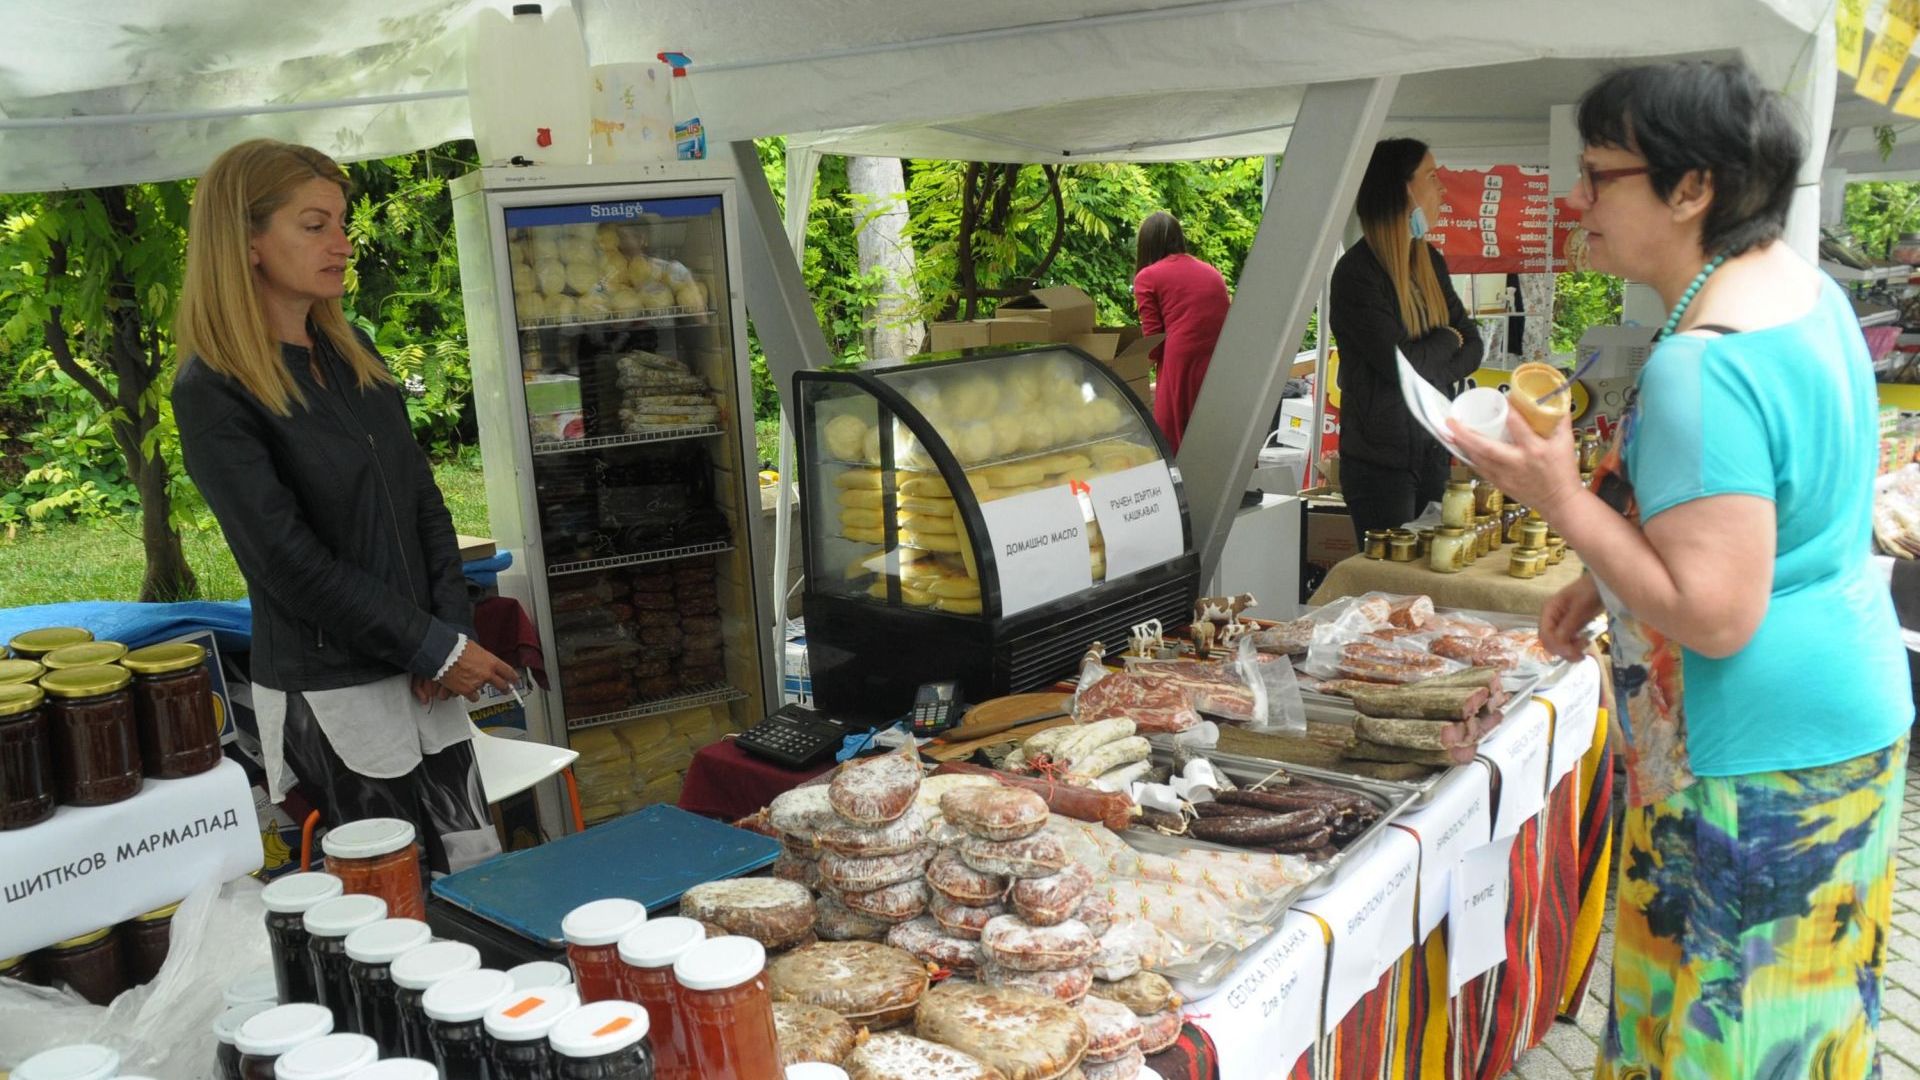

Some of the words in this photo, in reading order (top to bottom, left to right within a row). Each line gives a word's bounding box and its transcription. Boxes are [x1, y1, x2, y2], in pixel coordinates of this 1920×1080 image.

[590, 202, 643, 218] Snaigė
[1110, 495, 1133, 510] РЪЧЕН
[1134, 486, 1162, 504] ДЪРПАН
[1123, 503, 1160, 522] КАШКАВАЛ
[1006, 534, 1049, 556] ДОМАШНО
[1051, 527, 1079, 543] МАСЛО
[4, 852, 107, 903] ШИПКОВ
[116, 809, 239, 863] МАРМАЛАД
[1226, 968, 1268, 1010] СЕЛСКА
[1263, 928, 1309, 974] ЛУКАНКА
